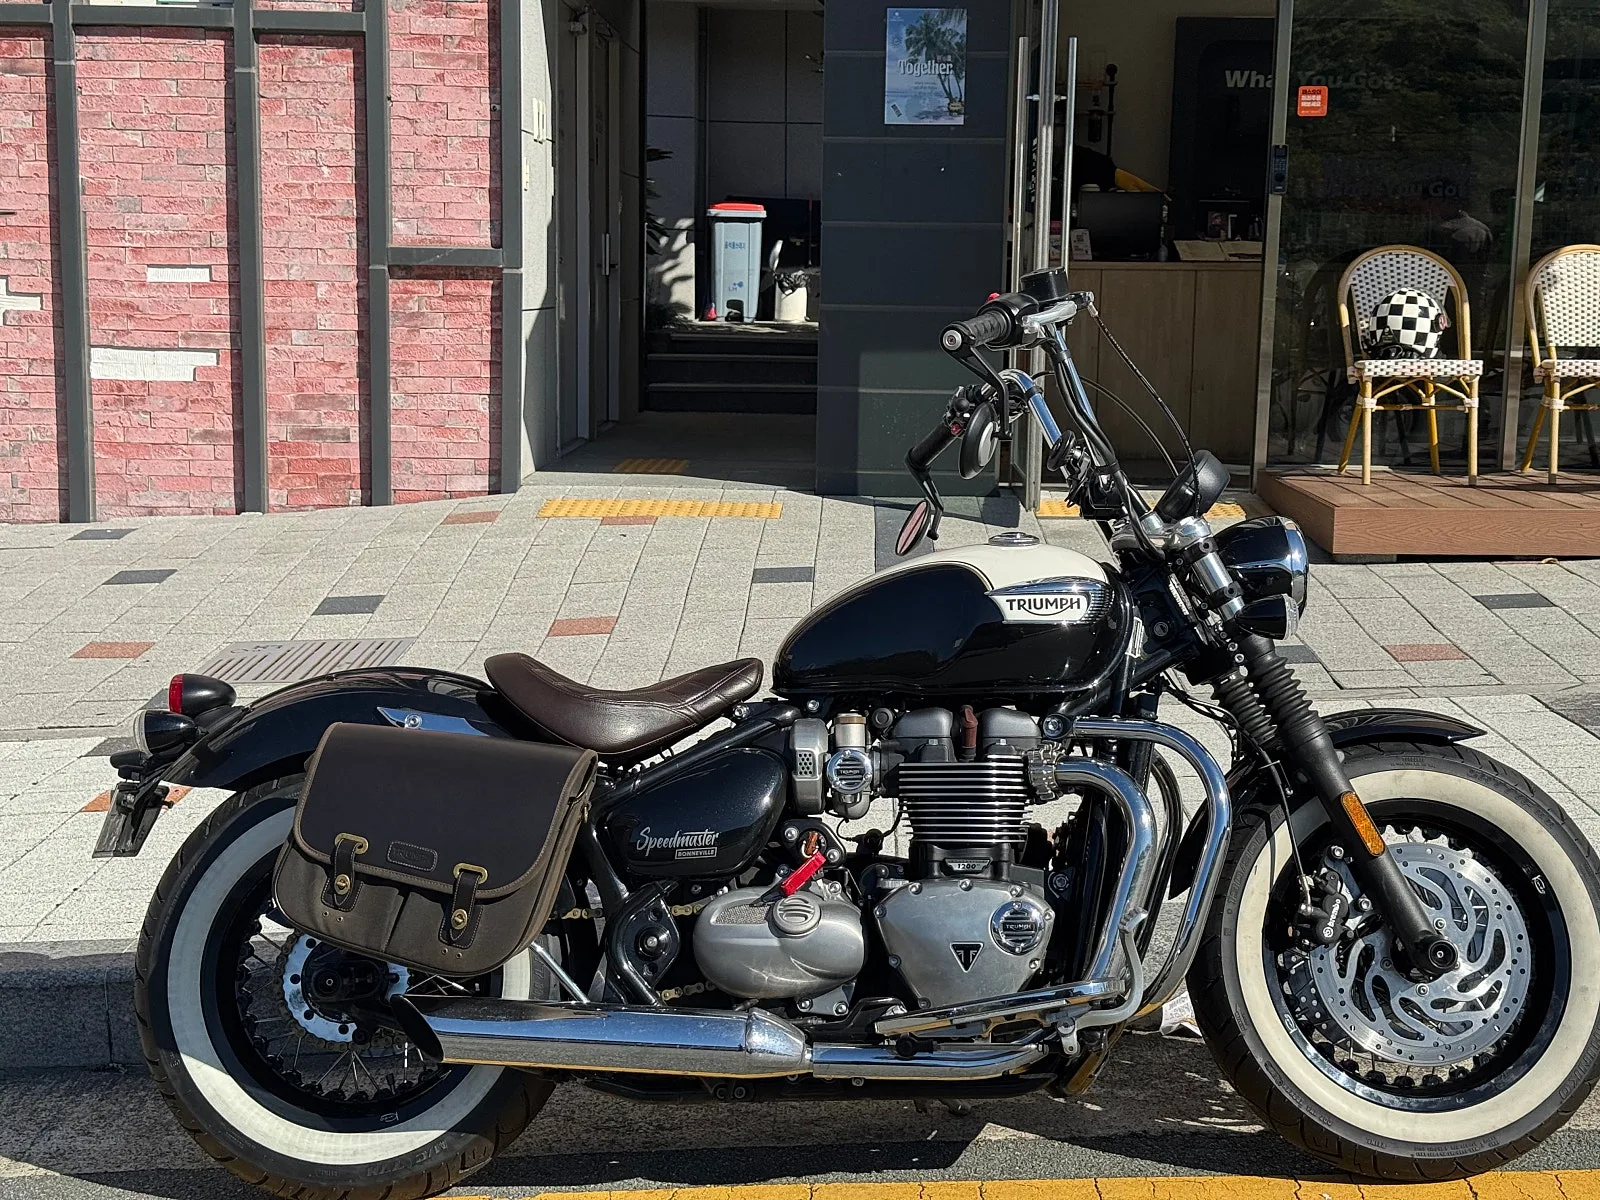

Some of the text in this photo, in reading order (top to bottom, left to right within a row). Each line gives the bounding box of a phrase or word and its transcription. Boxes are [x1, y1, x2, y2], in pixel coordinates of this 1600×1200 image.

[1225, 70, 1274, 88] Wha
[1006, 598, 1081, 616] TRIUMPH
[636, 826, 720, 857] Speedmaster
[677, 849, 715, 857] BONNEVILLE
[1327, 898, 1341, 928] brembo
